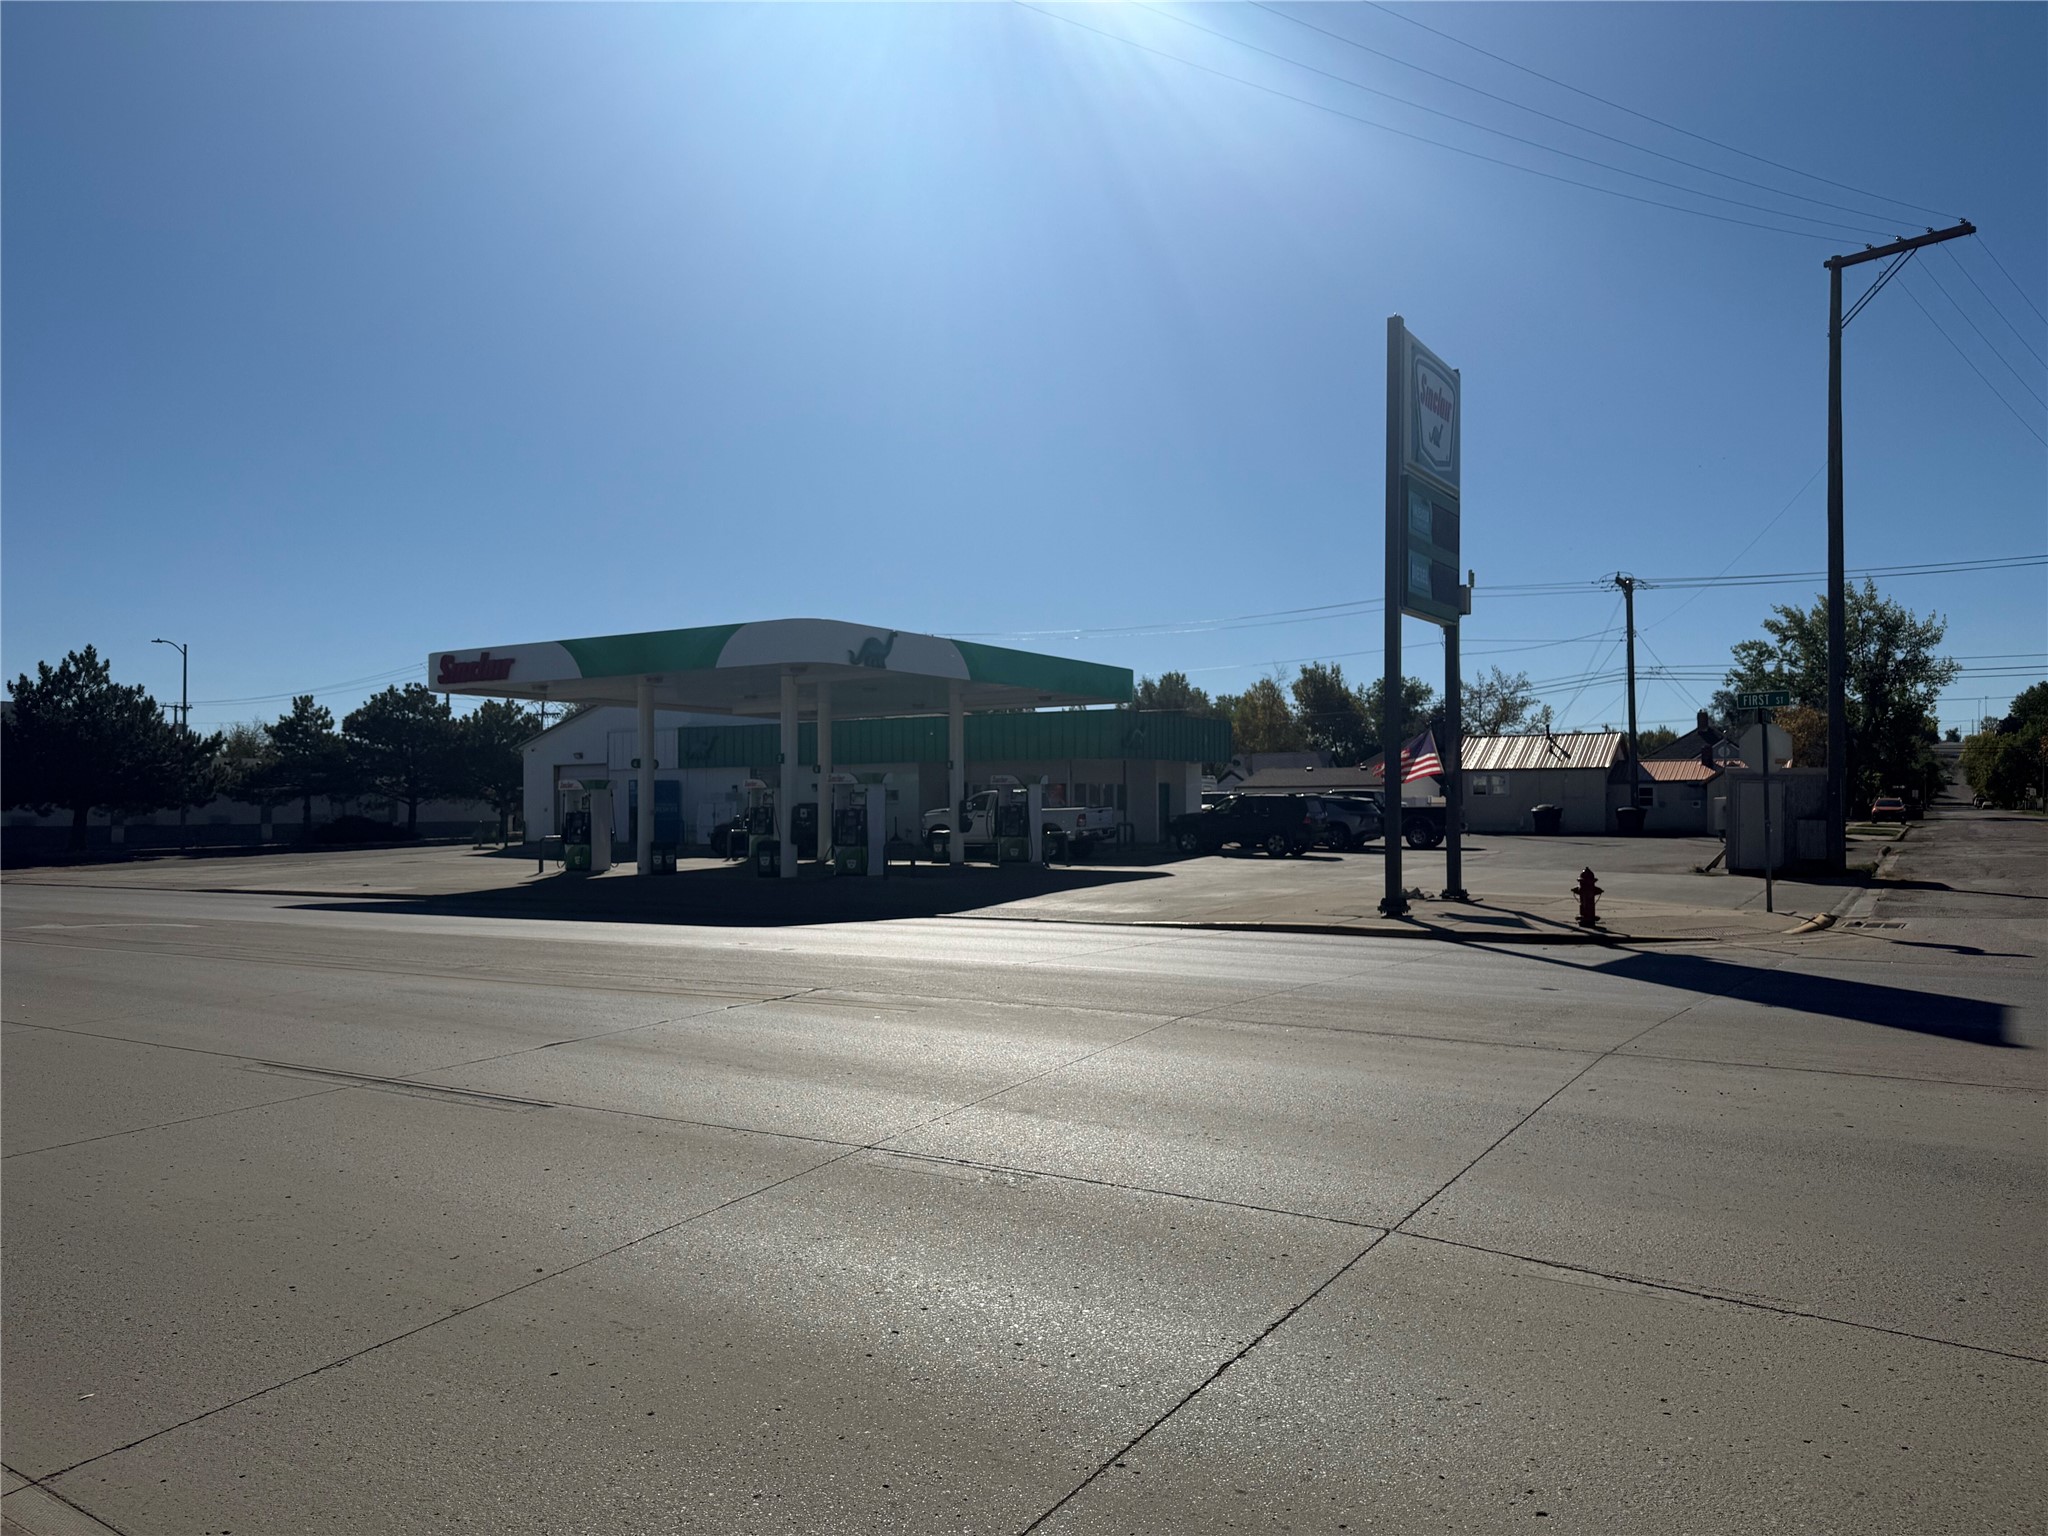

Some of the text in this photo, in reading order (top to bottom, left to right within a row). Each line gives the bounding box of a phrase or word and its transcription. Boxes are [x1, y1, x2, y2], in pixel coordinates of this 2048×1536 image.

[1420, 373, 1452, 423] Sinclair
[1743, 694, 1784, 706] FIRST ST
